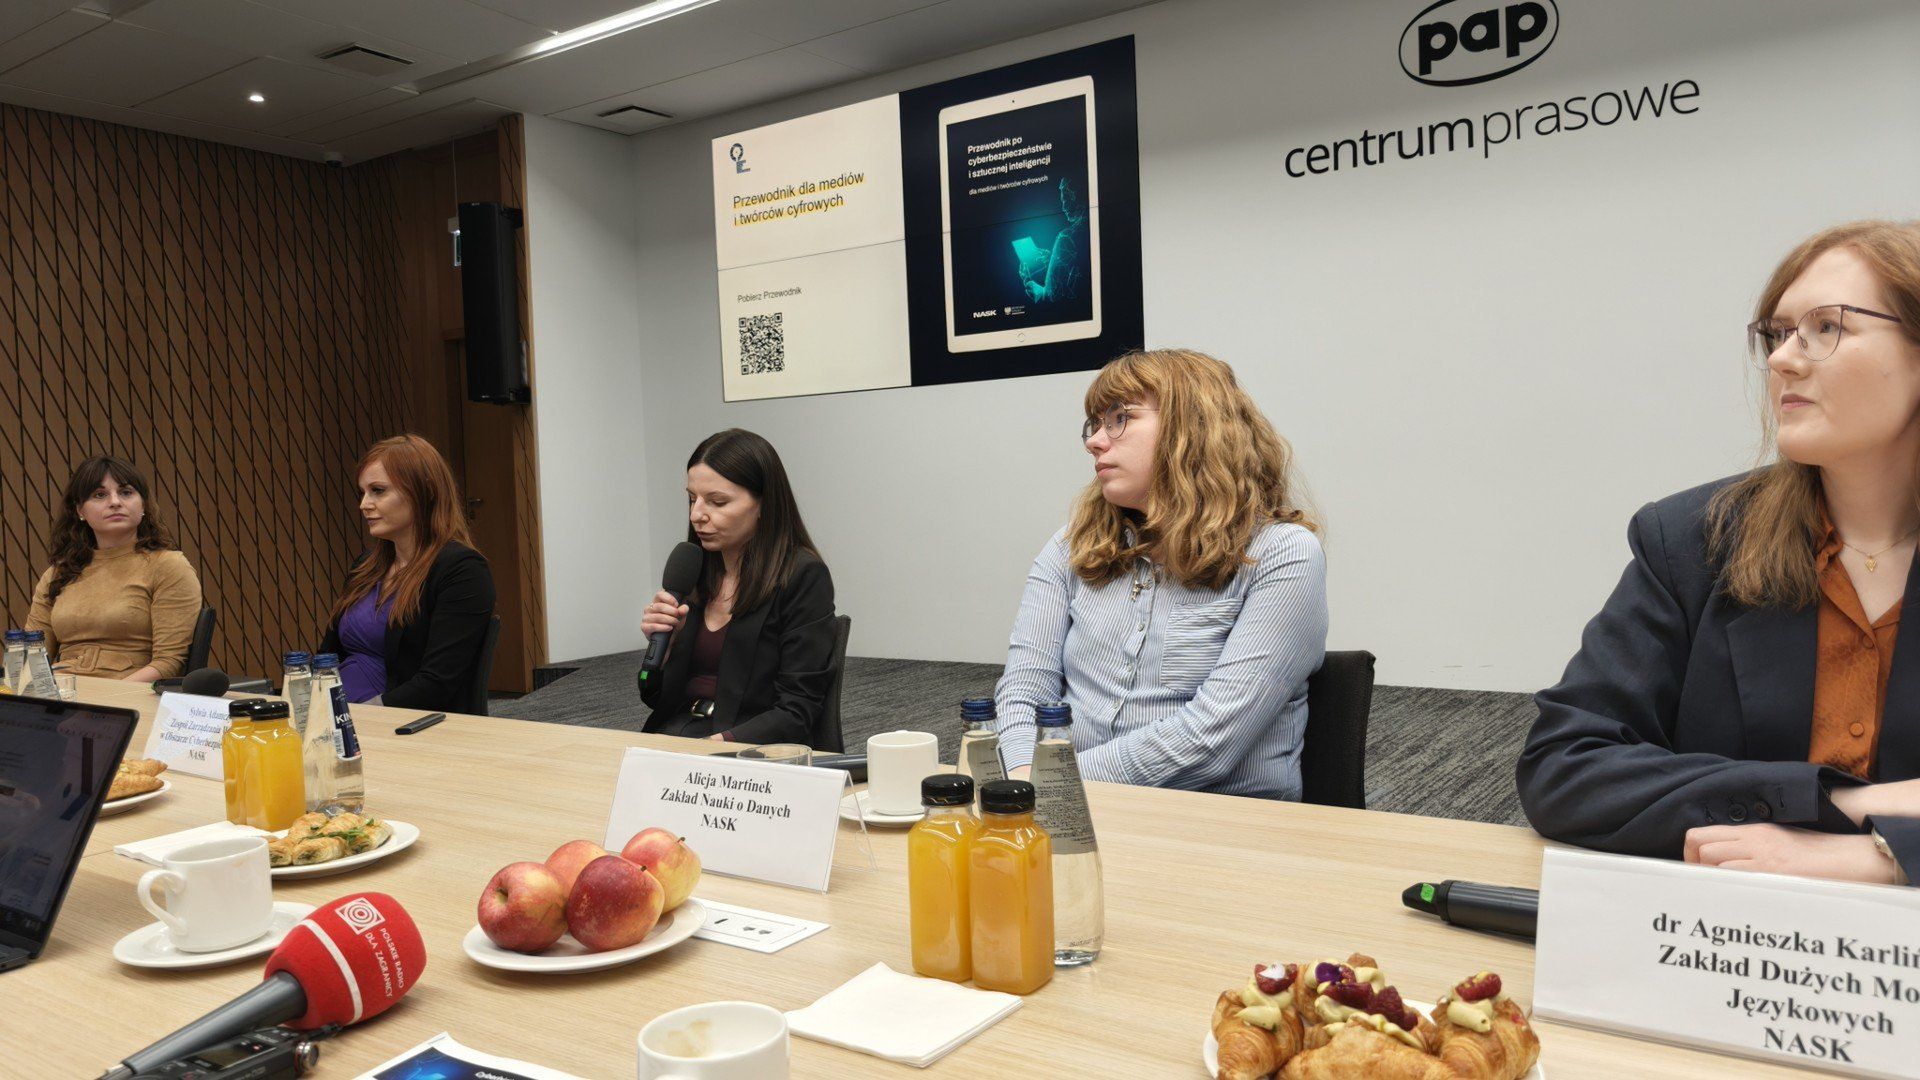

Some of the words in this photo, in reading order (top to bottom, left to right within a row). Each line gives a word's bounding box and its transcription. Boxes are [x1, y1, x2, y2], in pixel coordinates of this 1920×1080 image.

[1417, 1, 1549, 76] pap
[967, 138, 1011, 154] Przewodnik
[1012, 136, 1023, 146] po
[1284, 117, 1474, 178] centrum
[1482, 79, 1700, 158] prasowe
[967, 142, 1052, 166] cyberbezpieczeństwie
[1009, 155, 1051, 171] inteligencji
[733, 184, 796, 209] Przewodnik
[798, 181, 816, 195] dla
[819, 172, 865, 191] mediów
[739, 207, 784, 225] twórców
[786, 194, 844, 219] cyfrowych
[737, 293, 762, 304] Pobierz
[763, 287, 803, 299] Przewodnik
[973, 309, 997, 319] NASK
[684, 771, 717, 789] Alicja
[718, 774, 773, 794] Martinek
[660, 787, 699, 805] Zakład
[702, 793, 735, 811] Nauki
[736, 801, 744, 811] o
[746, 799, 791, 819] Danych
[701, 813, 738, 832] NASK
[1652, 912, 1682, 935] dr
[1689, 918, 1825, 955] Agnieszka
[365, 932, 378, 950] DLA
[375, 951, 393, 998] ZAGRANICY
[380, 927, 399, 961] POLSKIE
[394, 960, 404, 989] RADIO
[1657, 944, 1750, 978] Zakład
[1758, 958, 1862, 995] Dużych
[1726, 988, 1895, 1035] Językowych
[1763, 1026, 1854, 1063] NASK
